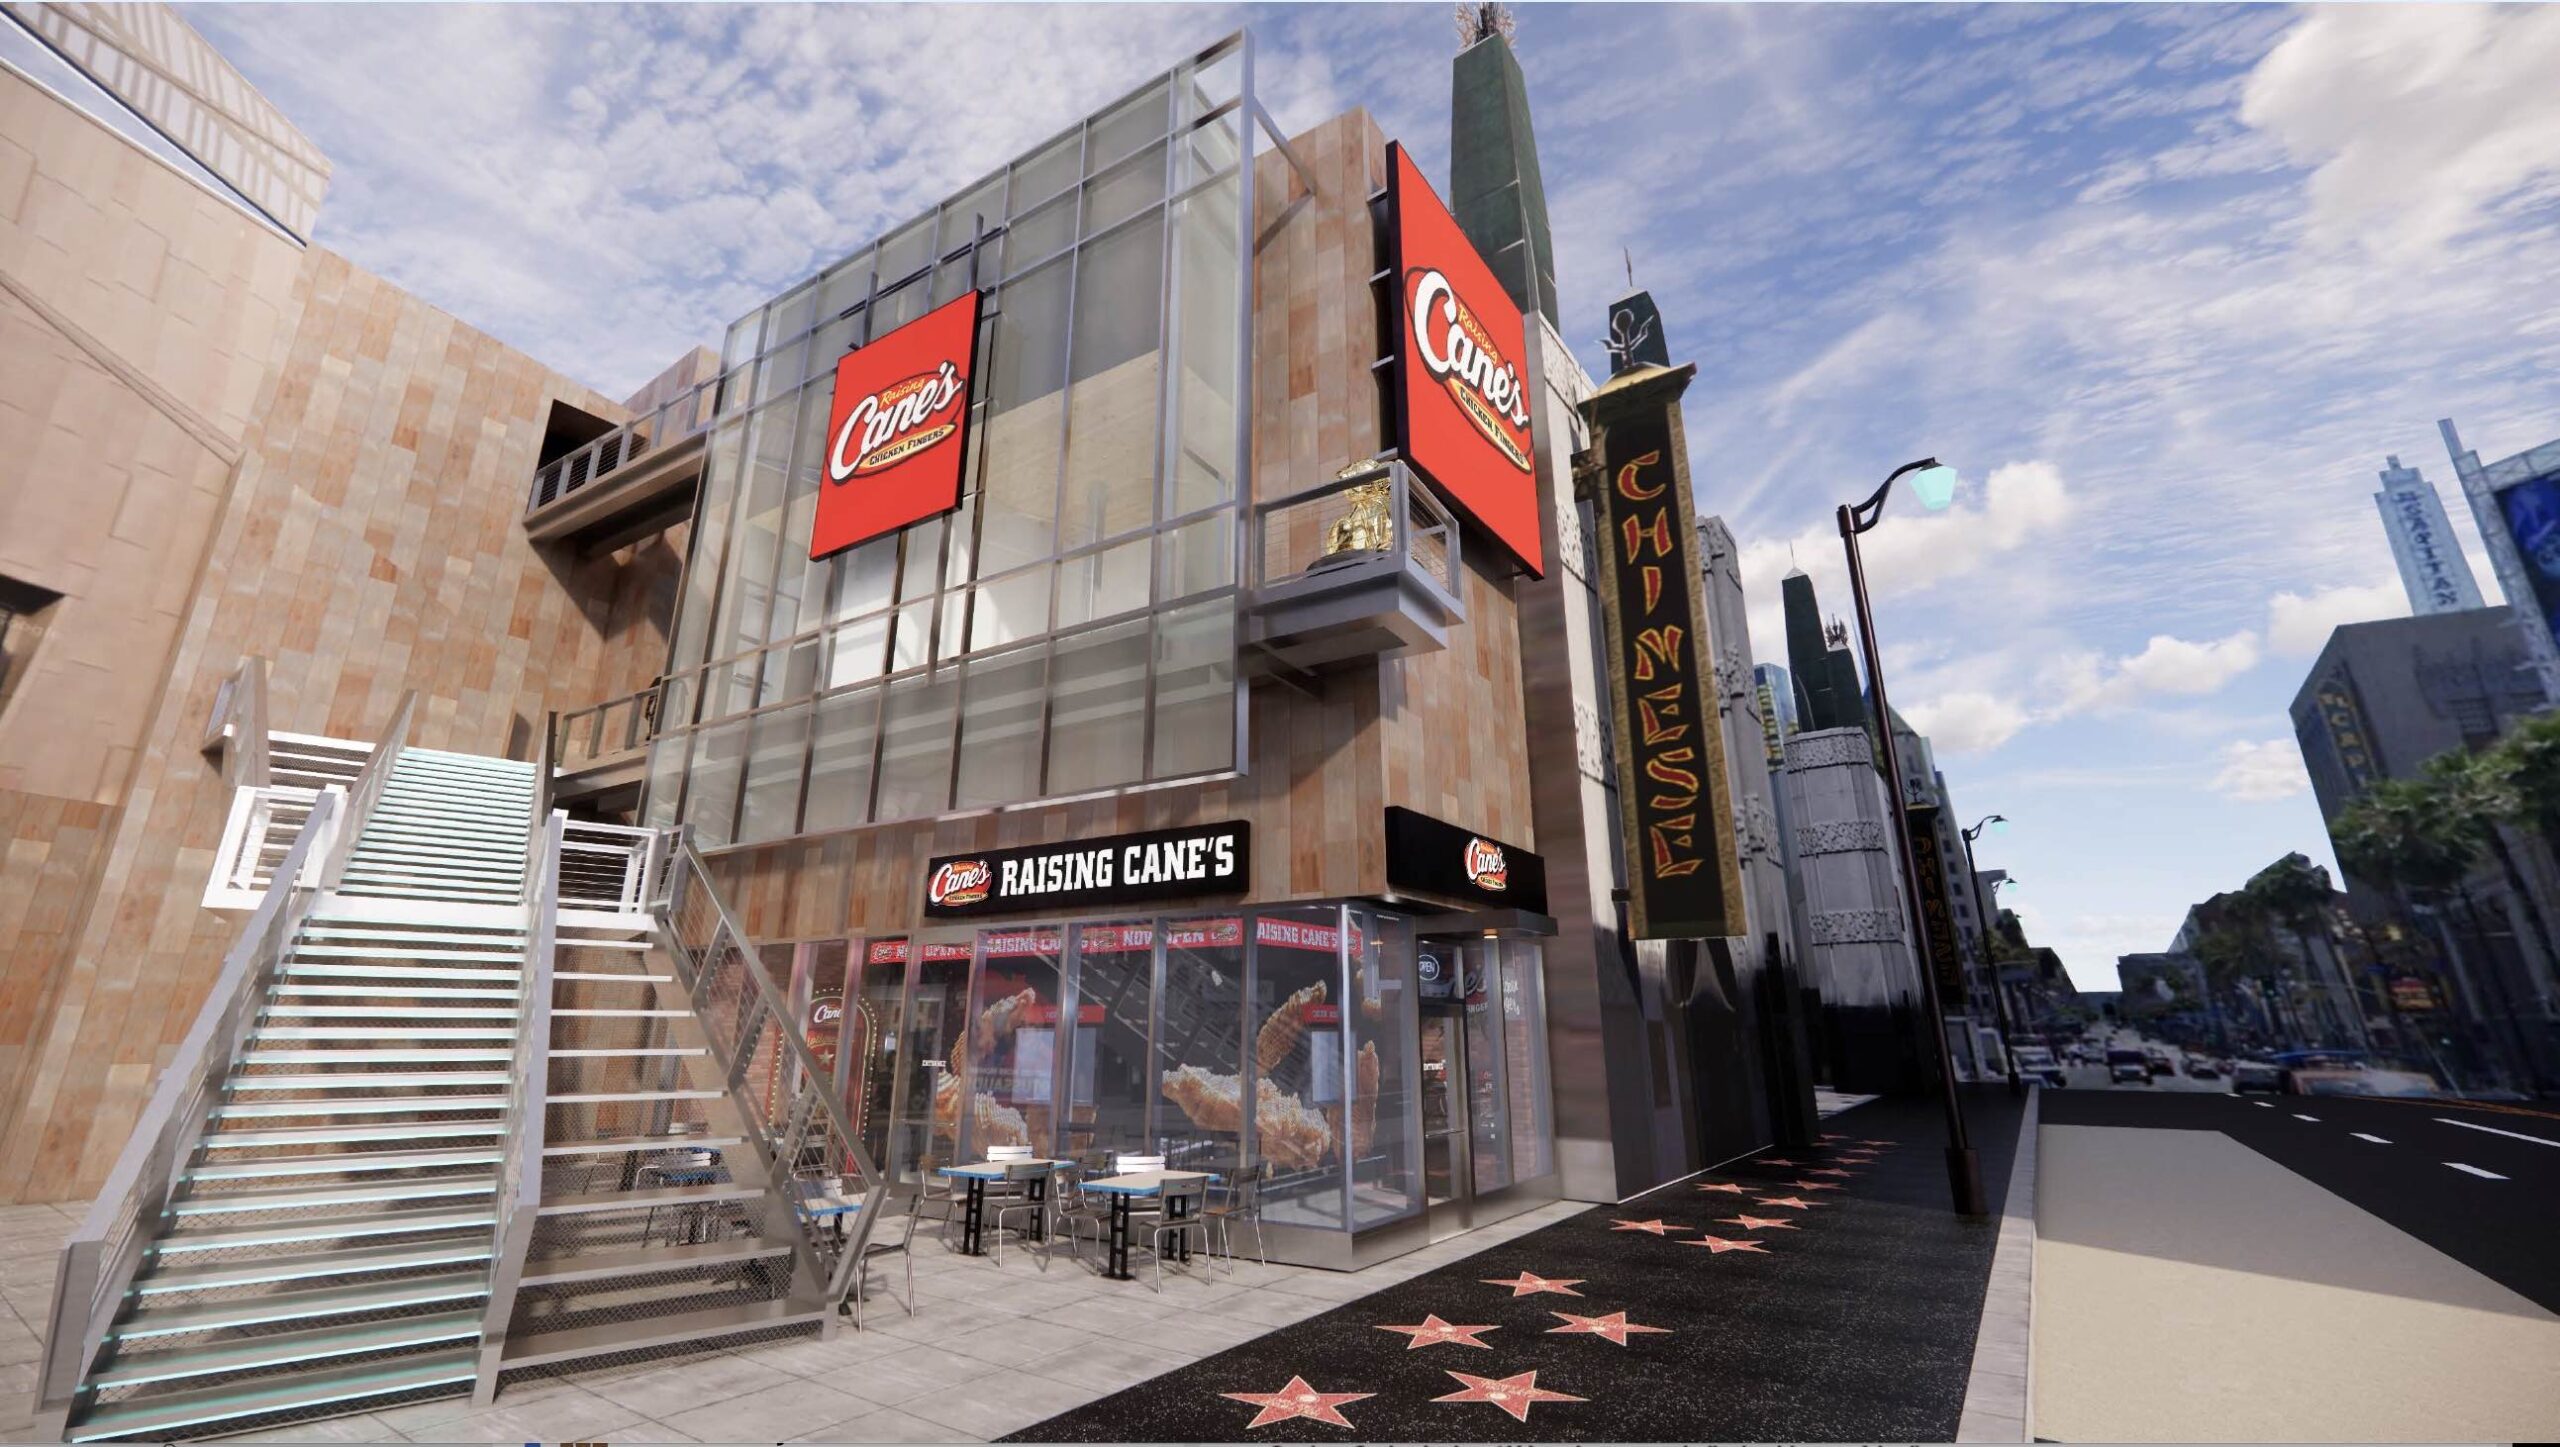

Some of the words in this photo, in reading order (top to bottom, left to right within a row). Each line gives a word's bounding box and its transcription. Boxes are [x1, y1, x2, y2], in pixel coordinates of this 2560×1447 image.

[1414, 270, 1529, 427] Cane's
[1457, 303, 1499, 364] Raising
[879, 377, 925, 410] Raising
[829, 361, 964, 481] Cane's
[868, 443, 906, 467] CHICKEN
[1616, 448, 1704, 881] CHINESE
[930, 860, 991, 903] Cane's
[1000, 848, 1113, 897] RAISING
[1123, 834, 1235, 885] CANE'S
[1467, 837, 1506, 880] Cane's
[1257, 921, 1299, 944] AISING
